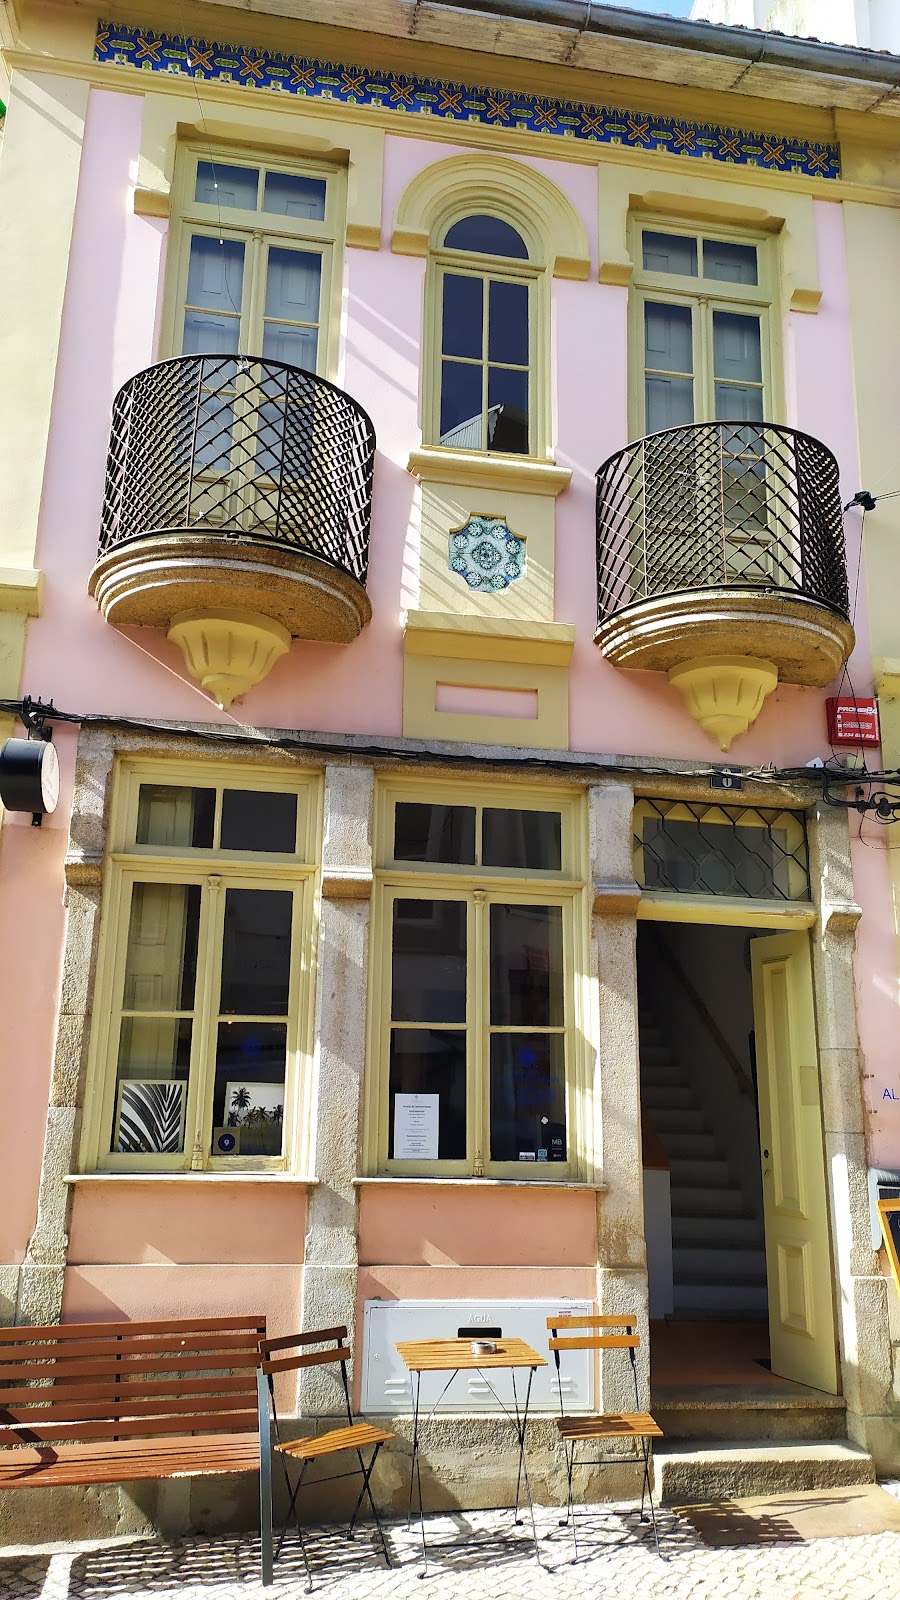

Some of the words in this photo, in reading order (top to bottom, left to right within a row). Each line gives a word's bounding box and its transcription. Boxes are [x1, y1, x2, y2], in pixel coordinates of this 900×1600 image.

[882, 1088, 900, 1100] AL
[223, 1139, 230, 1147] 9
[551, 1138, 563, 1146] MB
